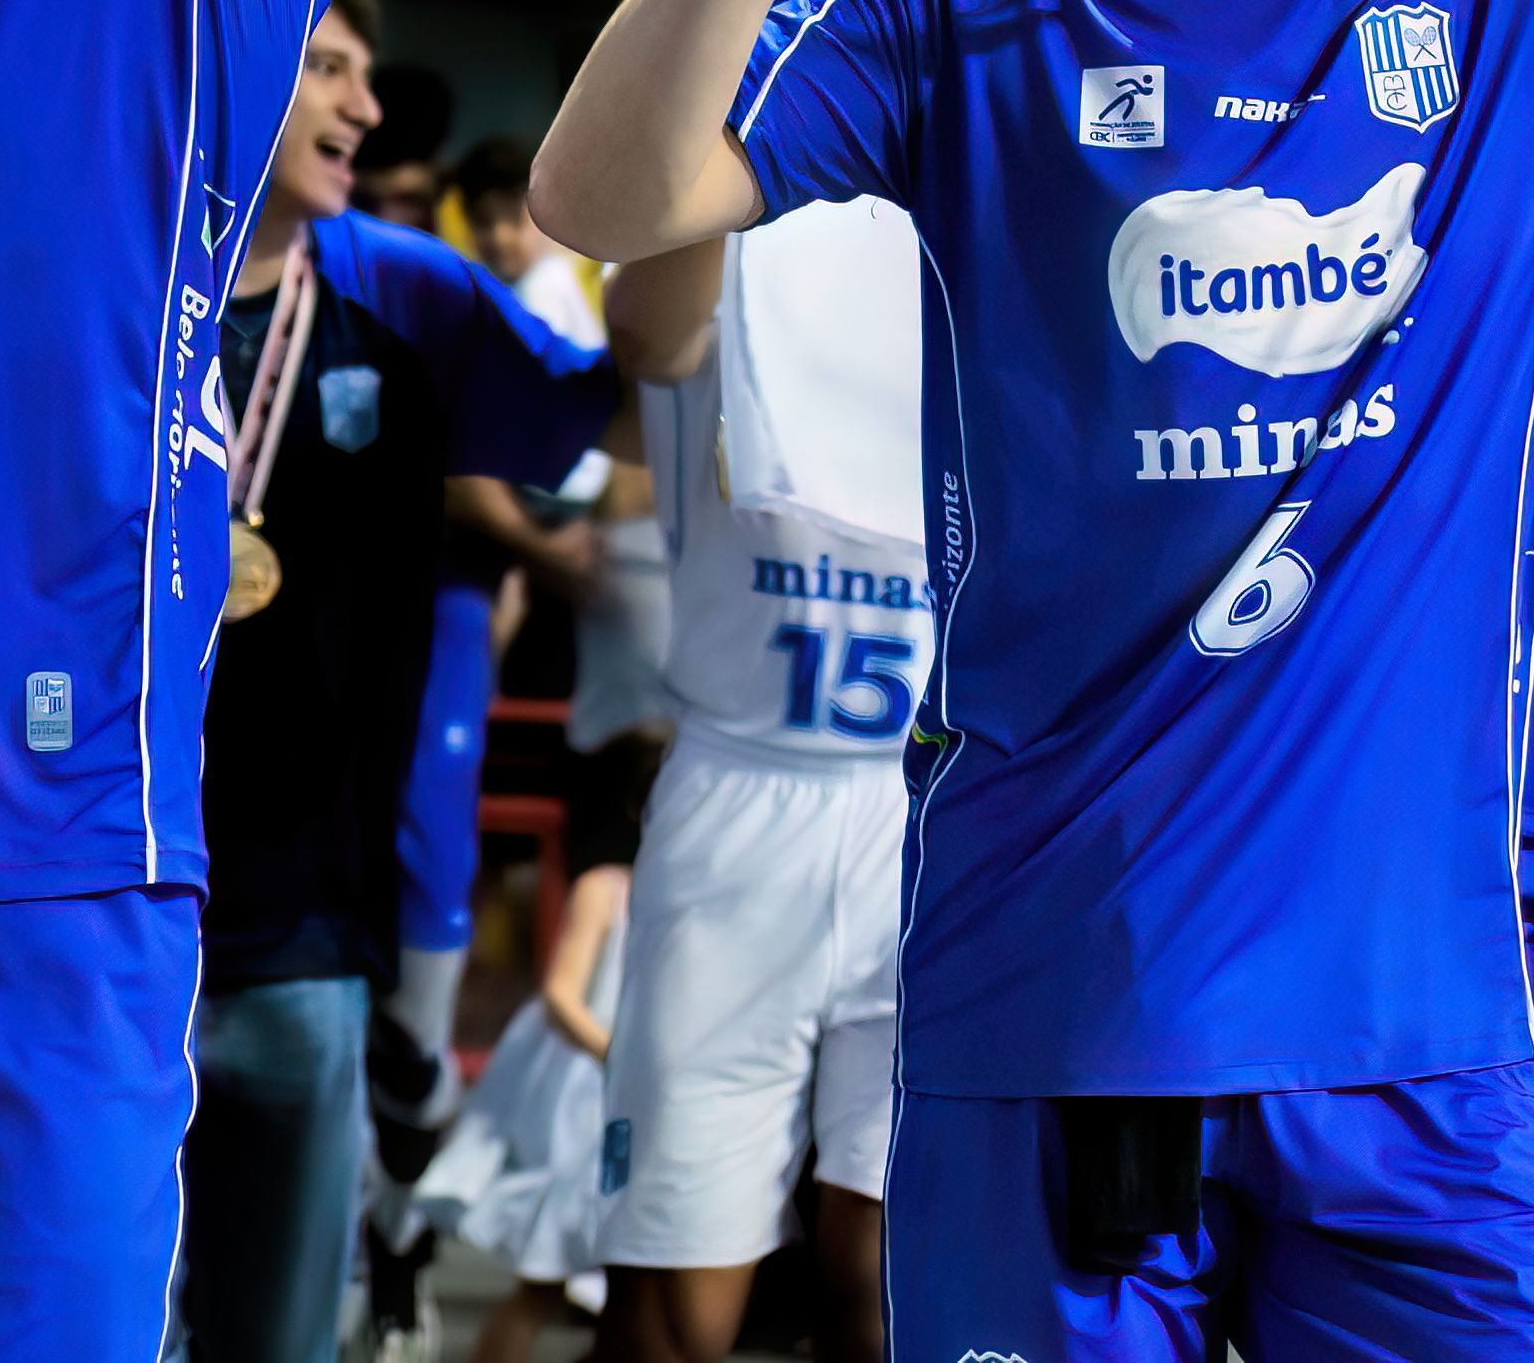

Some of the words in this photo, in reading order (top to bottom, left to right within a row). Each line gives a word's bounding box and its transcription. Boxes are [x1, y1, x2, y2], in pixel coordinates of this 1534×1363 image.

[1159, 232, 1388, 317] itambé
[1134, 383, 1397, 481] minas
[1189, 499, 1317, 658] 6
[768, 622, 917, 745] 15
